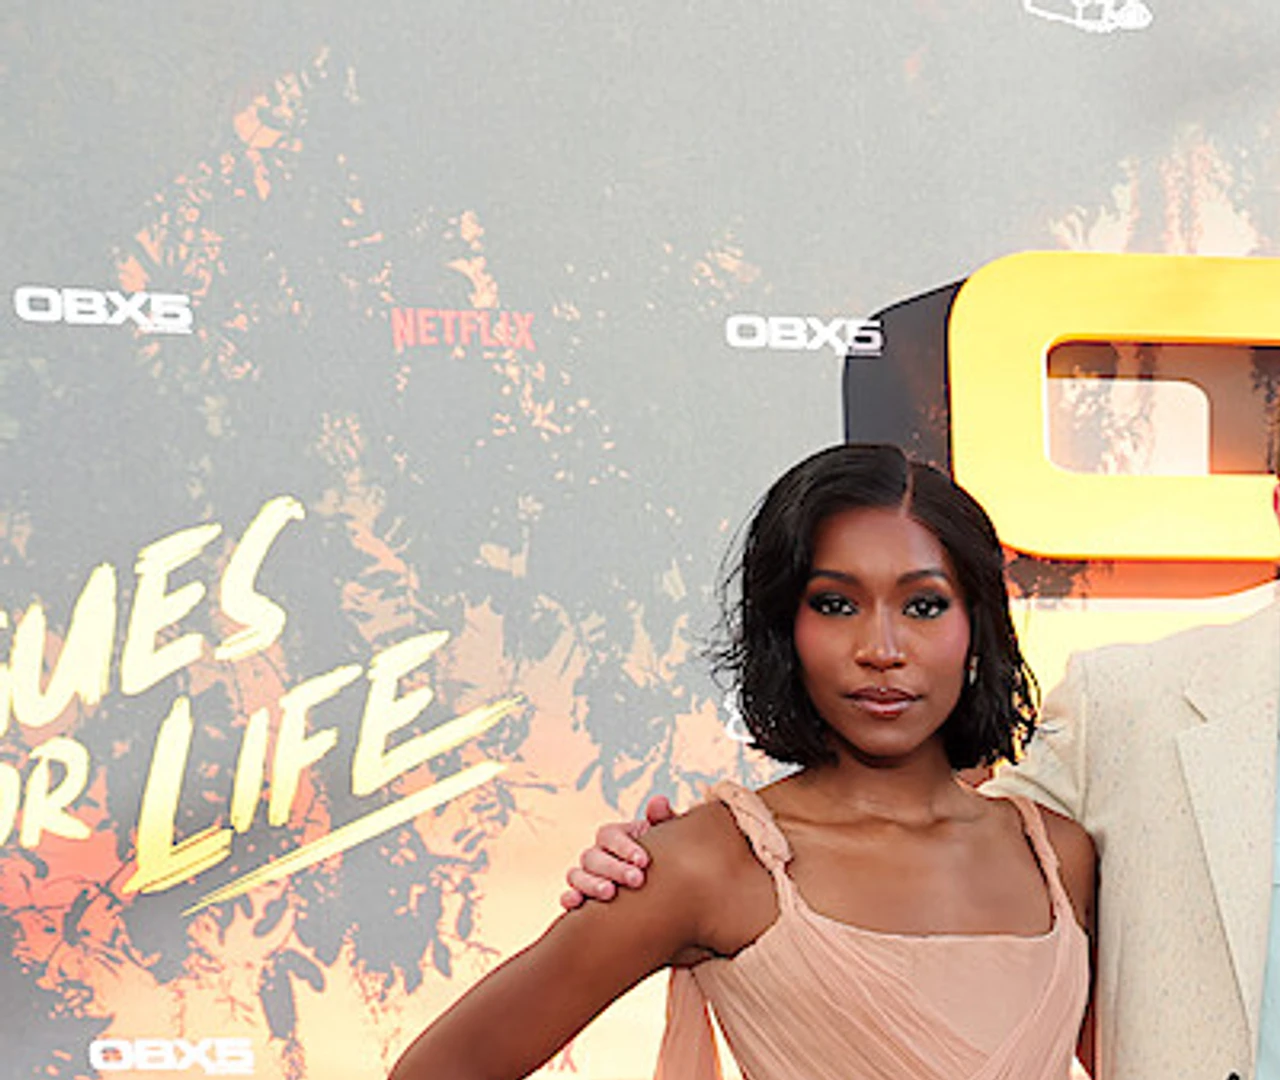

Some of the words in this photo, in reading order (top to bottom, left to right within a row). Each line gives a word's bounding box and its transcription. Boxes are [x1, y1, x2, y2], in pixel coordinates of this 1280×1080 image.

[14, 285, 193, 335] OBX5
[391, 306, 537, 353] NETFLIX
[726, 314, 885, 358] OBX5
[122, 629, 526, 896] LIFE
[89, 1037, 256, 1076] OBX5
